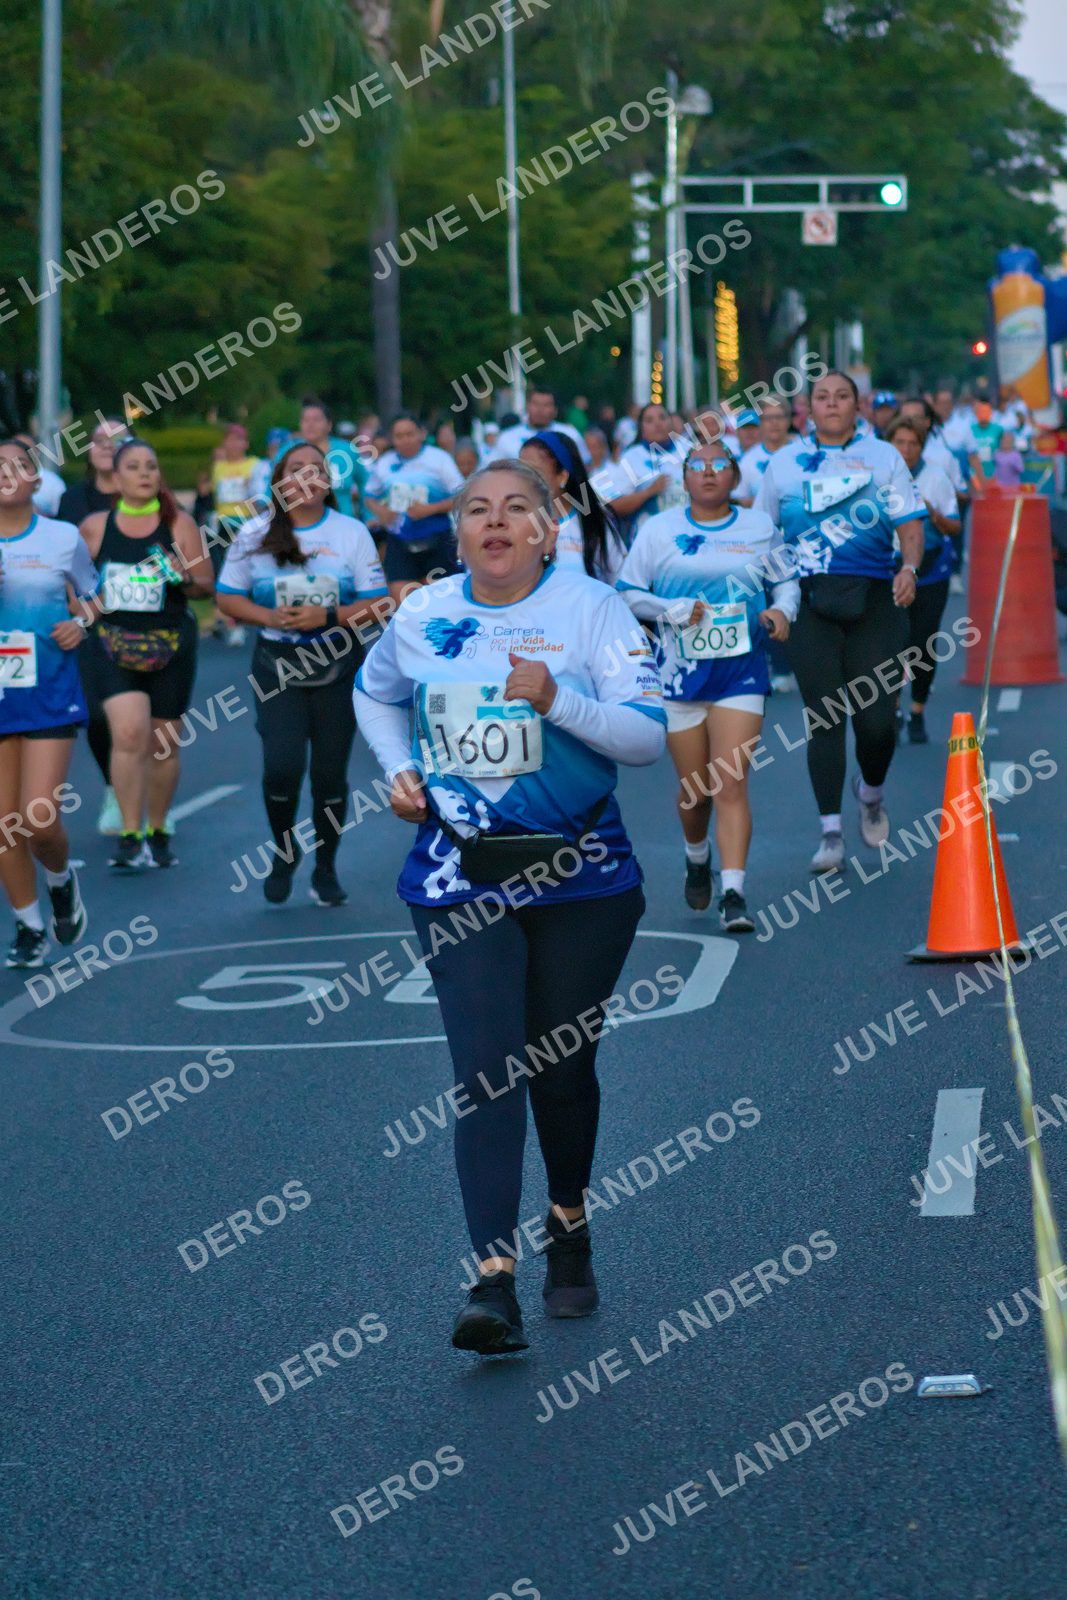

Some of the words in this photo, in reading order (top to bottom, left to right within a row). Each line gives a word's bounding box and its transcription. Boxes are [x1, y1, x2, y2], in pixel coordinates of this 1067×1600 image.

[493, 626, 545, 636] Carrera
[522, 635, 545, 645] Vida
[692, 626, 738, 651] 603
[509, 643, 565, 654] Integridad
[435, 723, 529, 764] 1601
